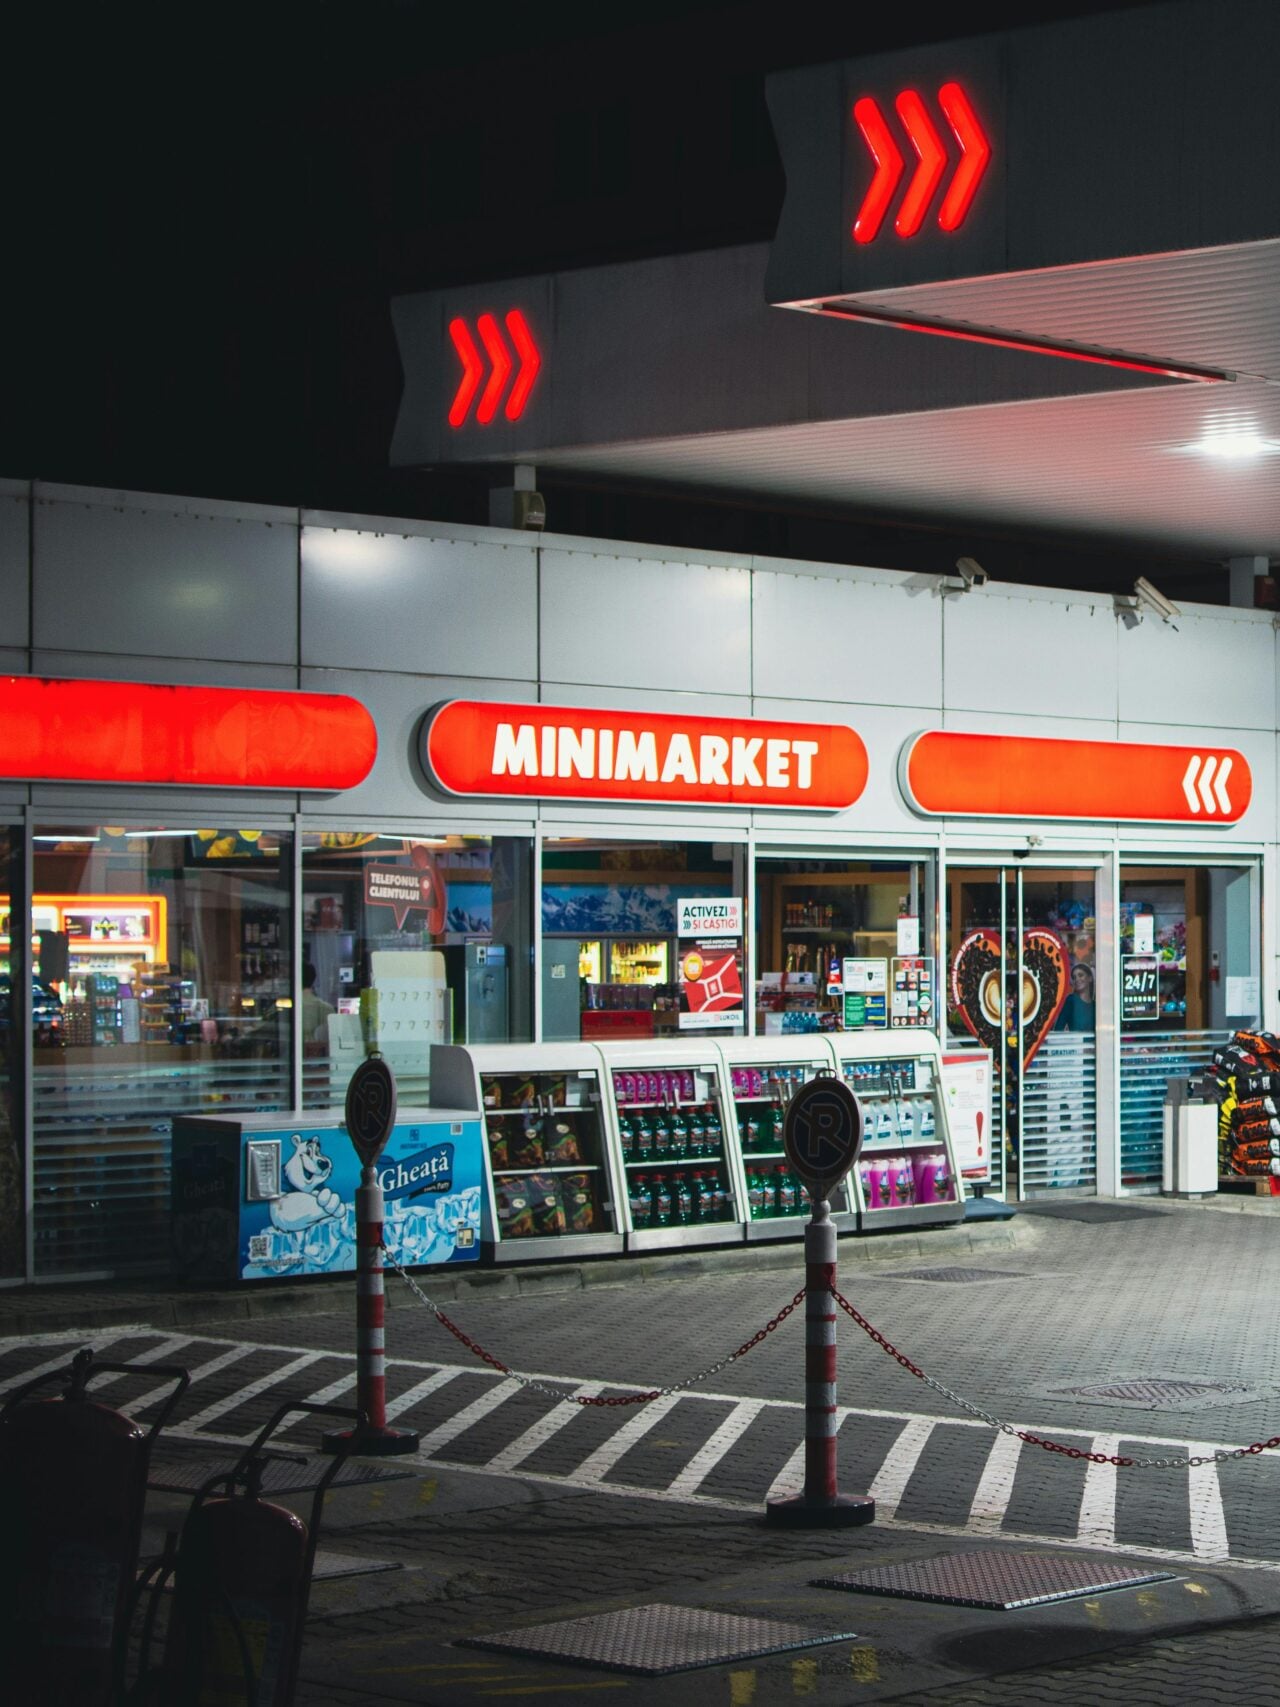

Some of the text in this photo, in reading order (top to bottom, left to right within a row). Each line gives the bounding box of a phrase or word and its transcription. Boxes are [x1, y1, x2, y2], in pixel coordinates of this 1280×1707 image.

[491, 722, 819, 790] MINIMARKET
[370, 872, 420, 888] TELEFONUL
[369, 886, 420, 901] CLIENTULUI
[682, 905, 728, 918] ACTIVEZI
[1124, 971, 1156, 993] 24/7
[378, 1150, 450, 1193] Gheață
